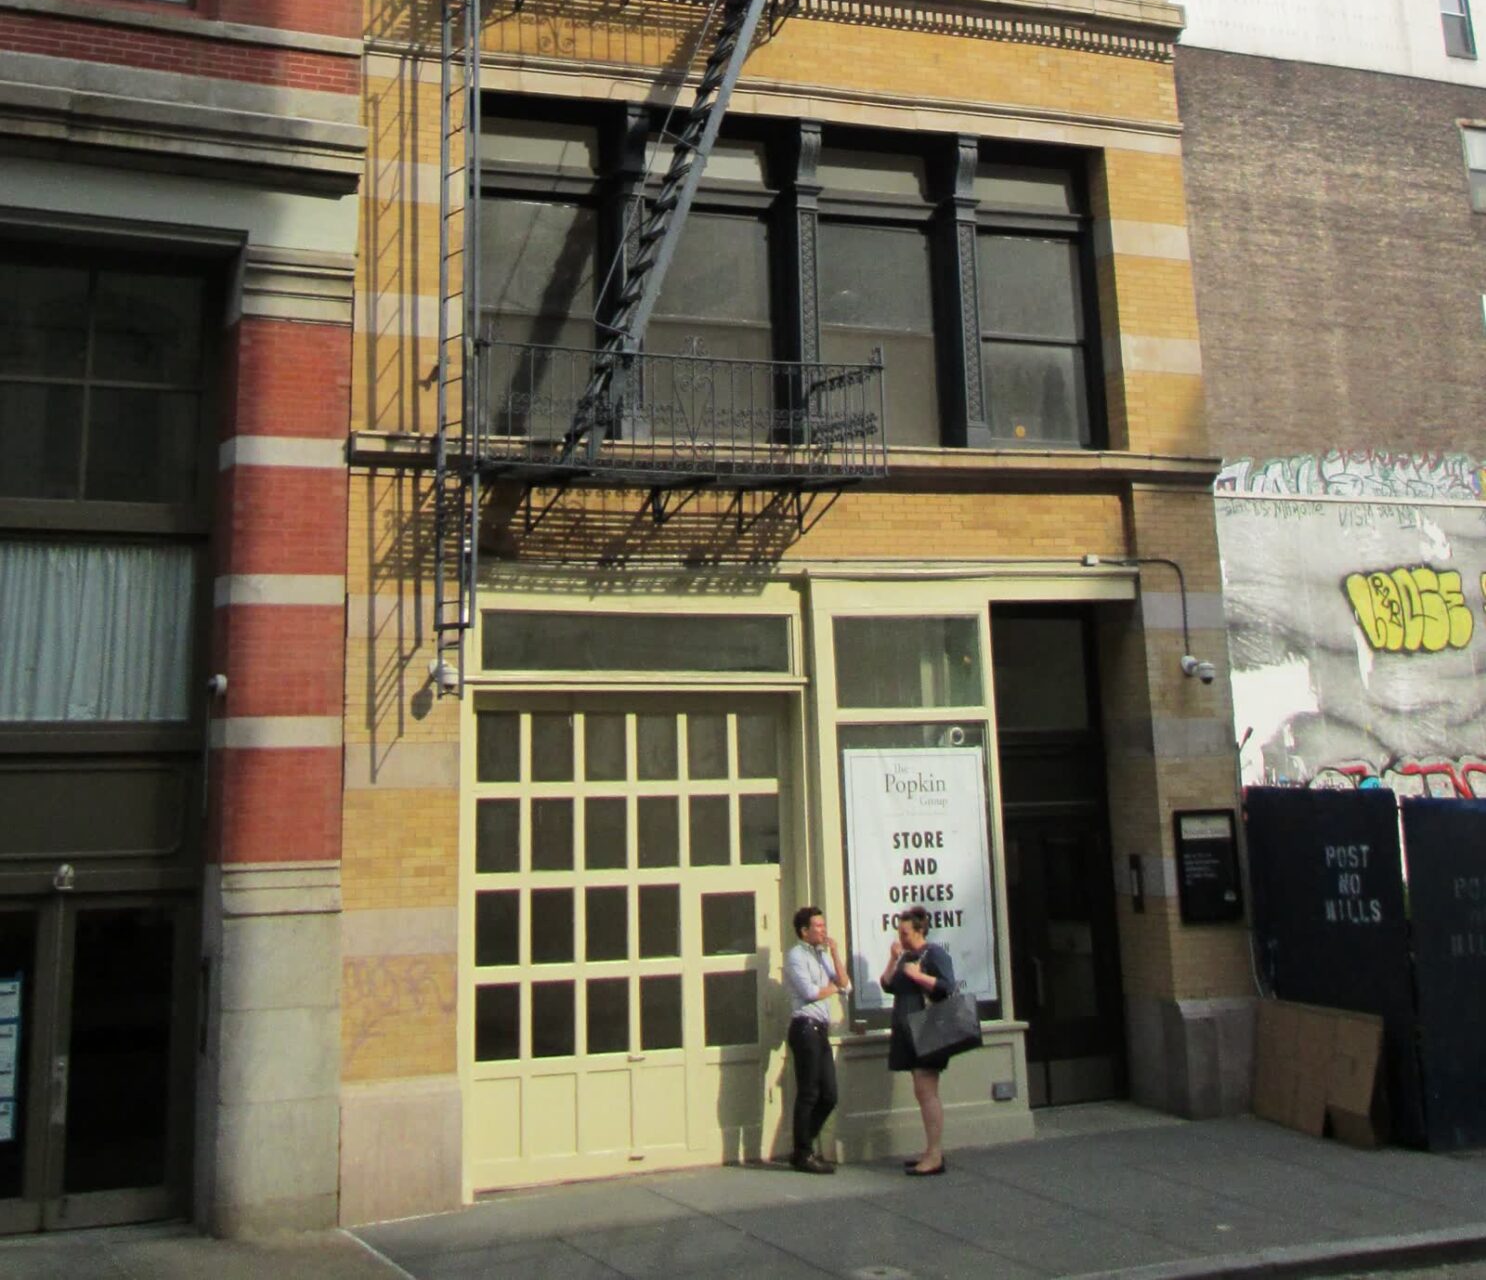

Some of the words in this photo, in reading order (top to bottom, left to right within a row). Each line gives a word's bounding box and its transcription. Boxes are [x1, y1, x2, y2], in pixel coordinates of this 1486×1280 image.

[885, 771, 946, 799] Popkin
[893, 830, 945, 849] STORE
[902, 857, 938, 876] AND
[1325, 845, 1370, 869] POST
[889, 883, 954, 904] OFFICES
[1338, 873, 1361, 895] NO
